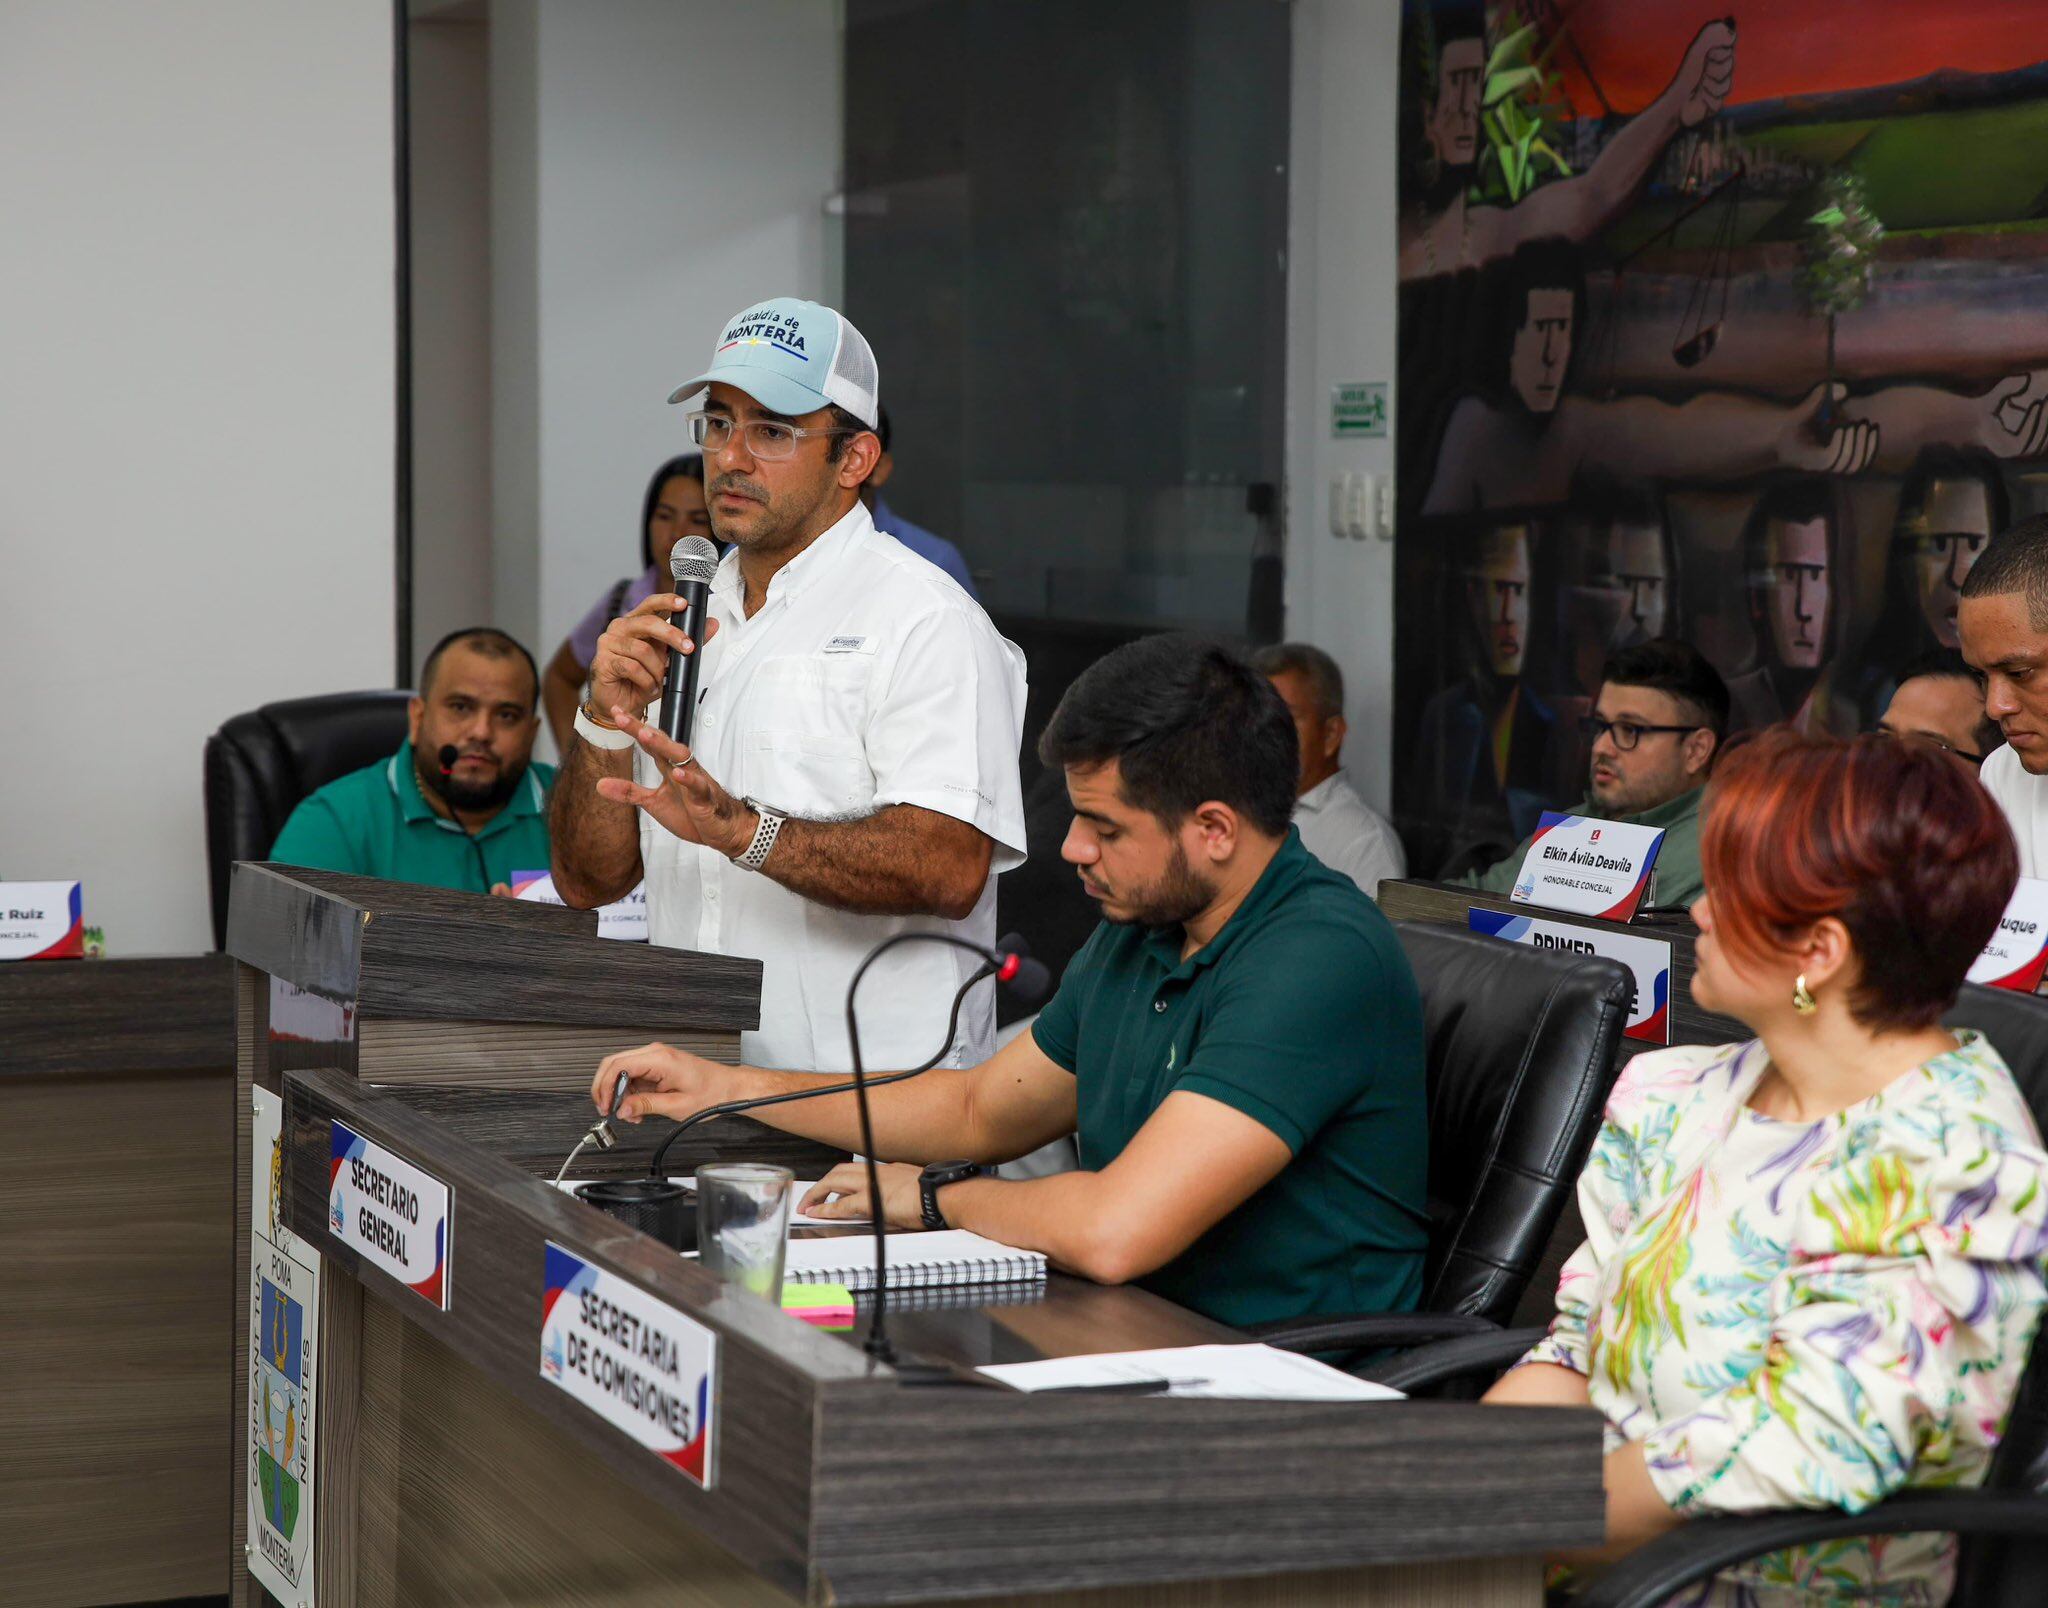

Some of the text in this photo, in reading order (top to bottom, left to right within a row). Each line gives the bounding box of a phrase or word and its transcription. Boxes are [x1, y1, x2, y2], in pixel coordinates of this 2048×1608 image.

[724, 324, 805, 351] MONTERÍA
[784, 317, 800, 329] de
[1542, 845, 1568, 862] Elkin
[1568, 847, 1595, 868] Ávila
[1542, 875, 1613, 895] HONORABLE CONCEJAL
[9, 908, 44, 919] Ruiz
[2000, 918, 2037, 934] uque
[1982, 945, 2009, 959] CEJAL
[351, 1156, 419, 1225] SECRETARIO
[358, 1206, 409, 1267] GENERAL
[272, 1253, 292, 1291] POMA
[580, 1286, 681, 1382] SECRETARIA
[567, 1331, 690, 1443] DE COMISIONES
[300, 1339, 310, 1484] NEPOTES
[260, 1524, 296, 1581] MONTERÍA
